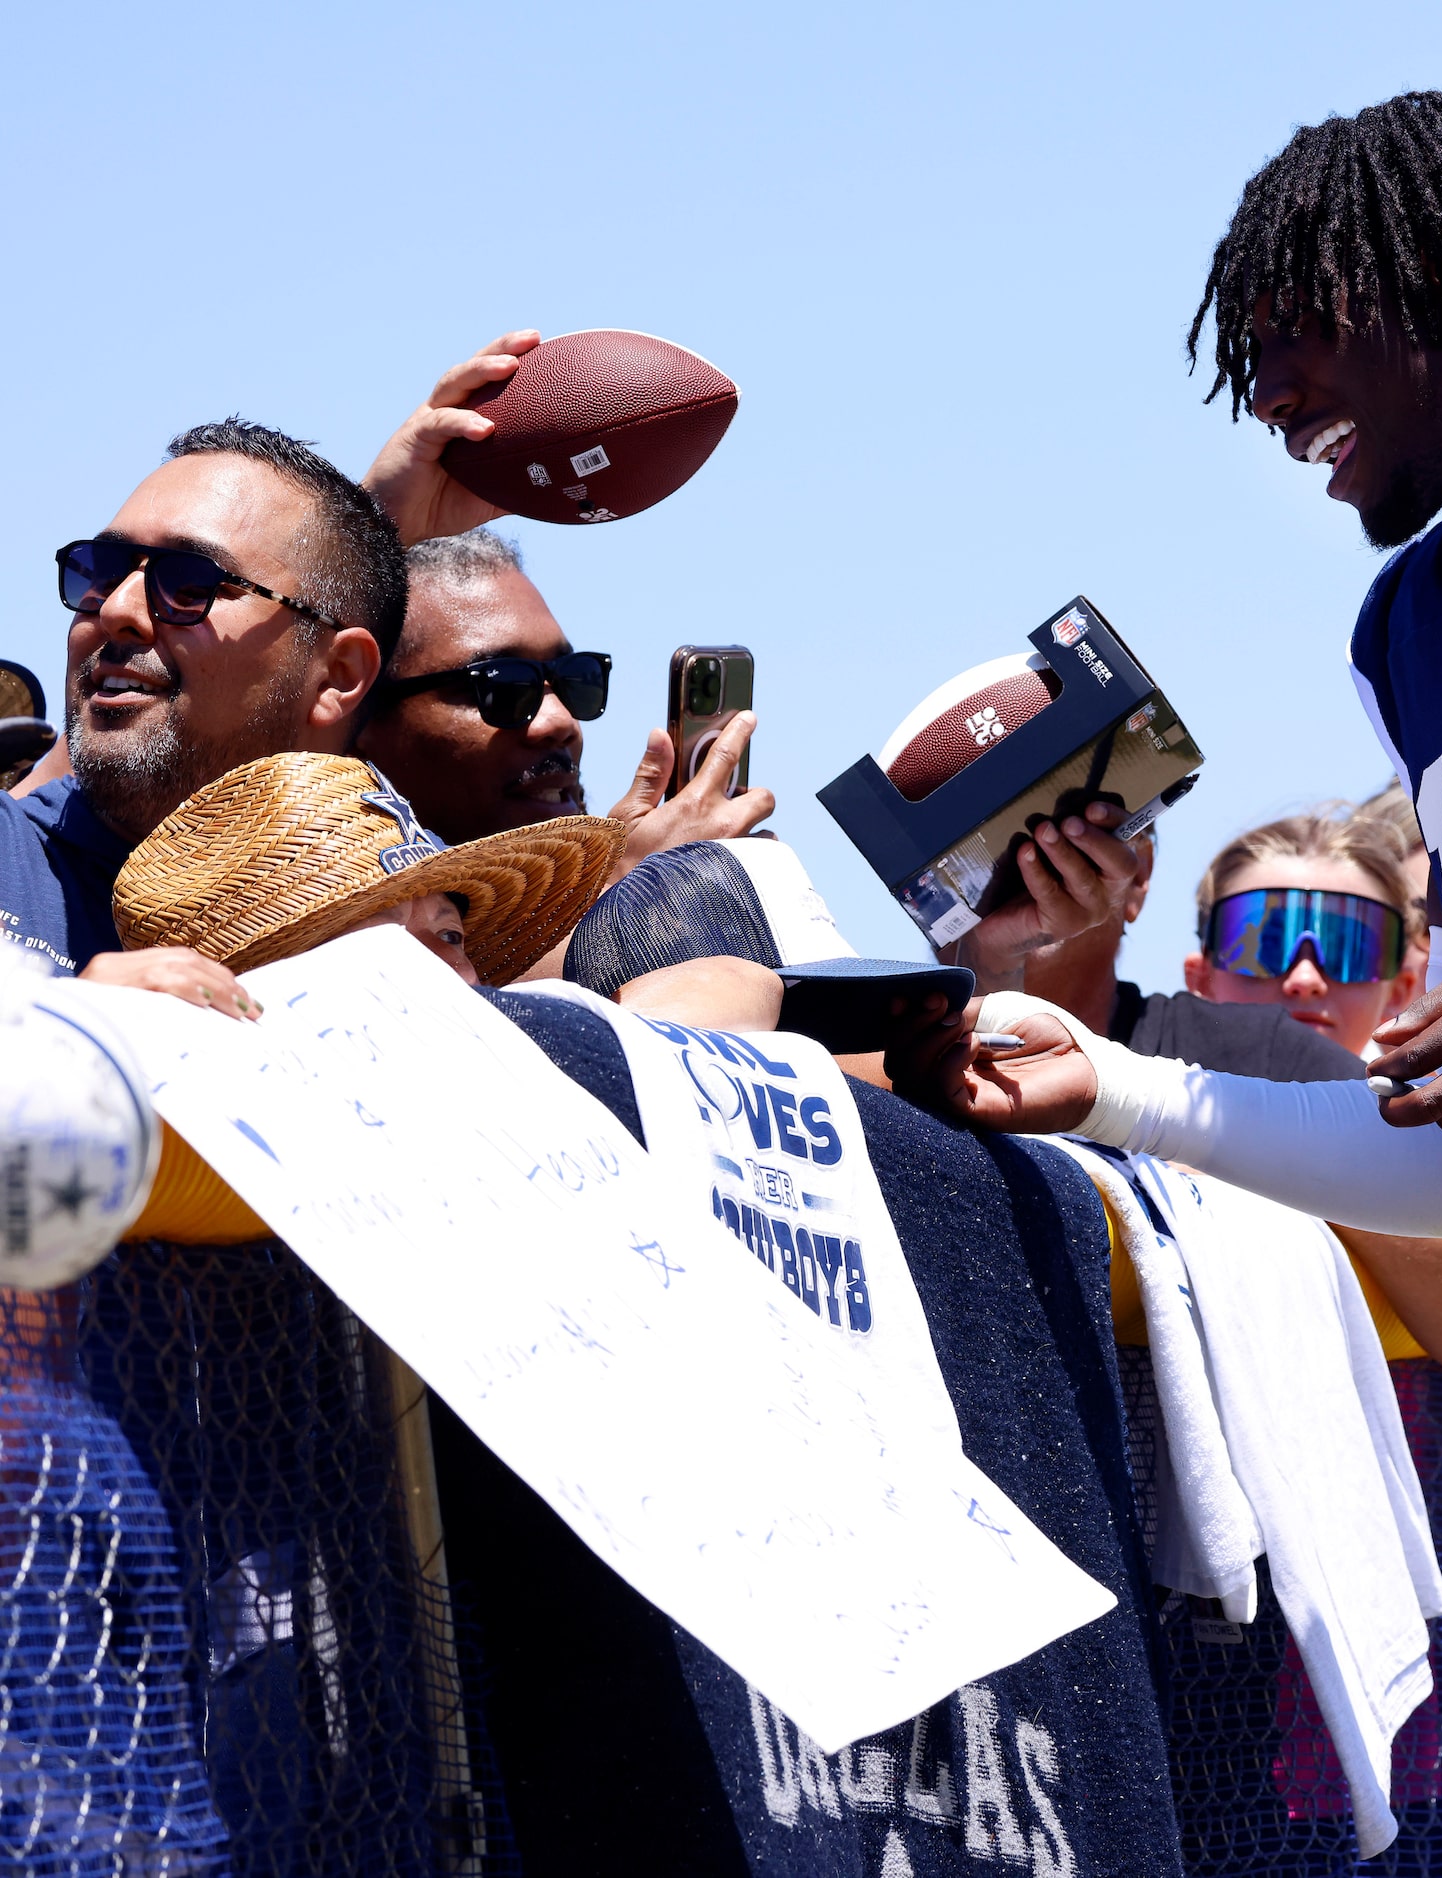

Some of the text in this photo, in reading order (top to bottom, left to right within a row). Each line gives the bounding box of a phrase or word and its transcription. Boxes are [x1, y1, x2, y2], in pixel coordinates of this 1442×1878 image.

[1056, 618, 1081, 645] NFL
[1074, 645, 1107, 688] FOOTBALL
[1080, 640, 1114, 680] MINI SIZE
[24, 937, 77, 970] DIVISION
[744, 1157, 799, 1212] HER
